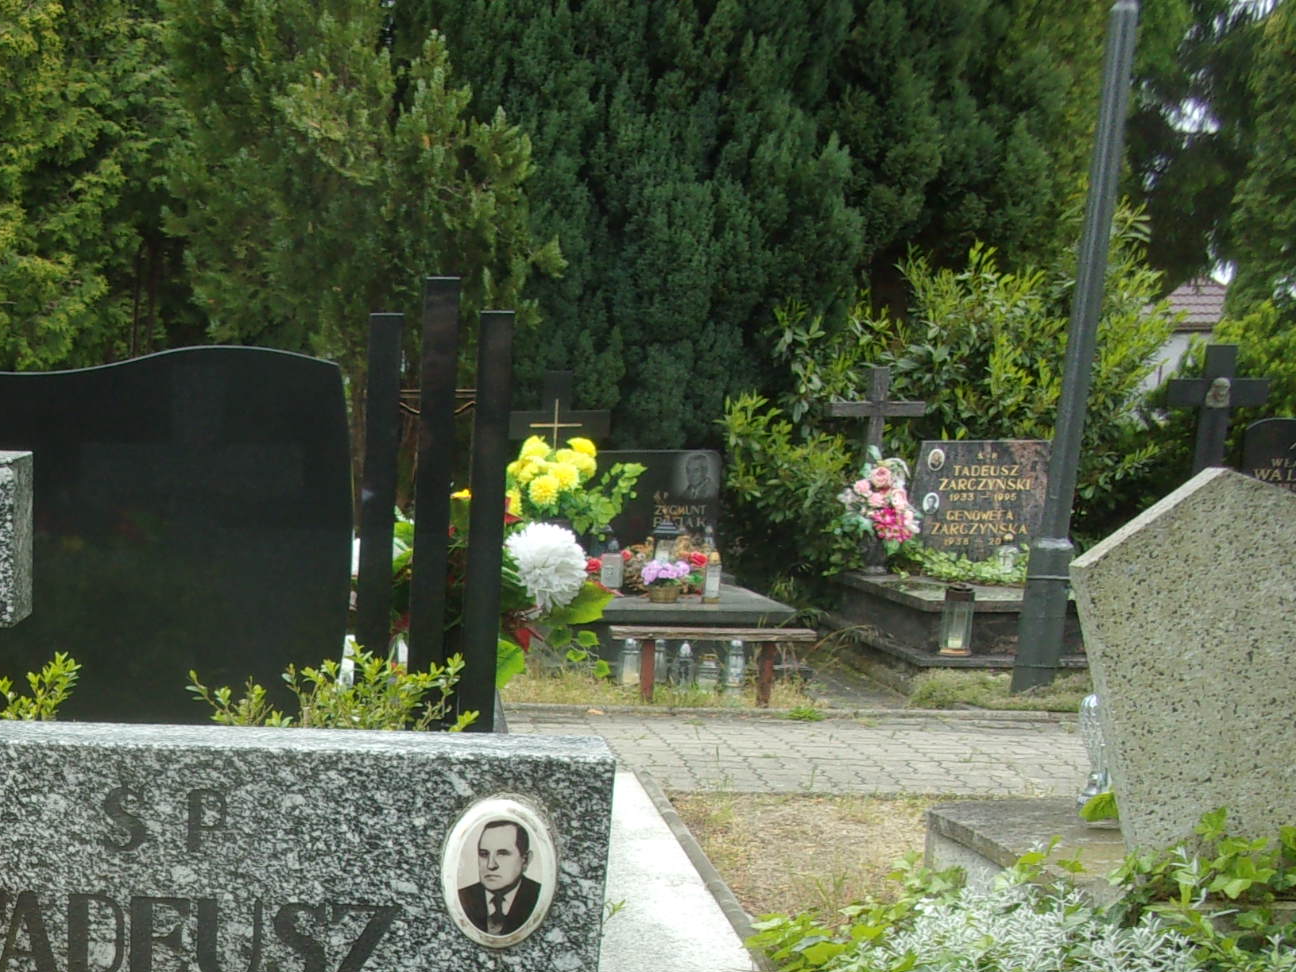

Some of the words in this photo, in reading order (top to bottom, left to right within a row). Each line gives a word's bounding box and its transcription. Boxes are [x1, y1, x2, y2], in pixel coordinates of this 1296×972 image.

[953, 465, 1020, 477] TADEUSZ
[946, 510, 1014, 520] GENOWEFA
[187, 788, 227, 850] P
